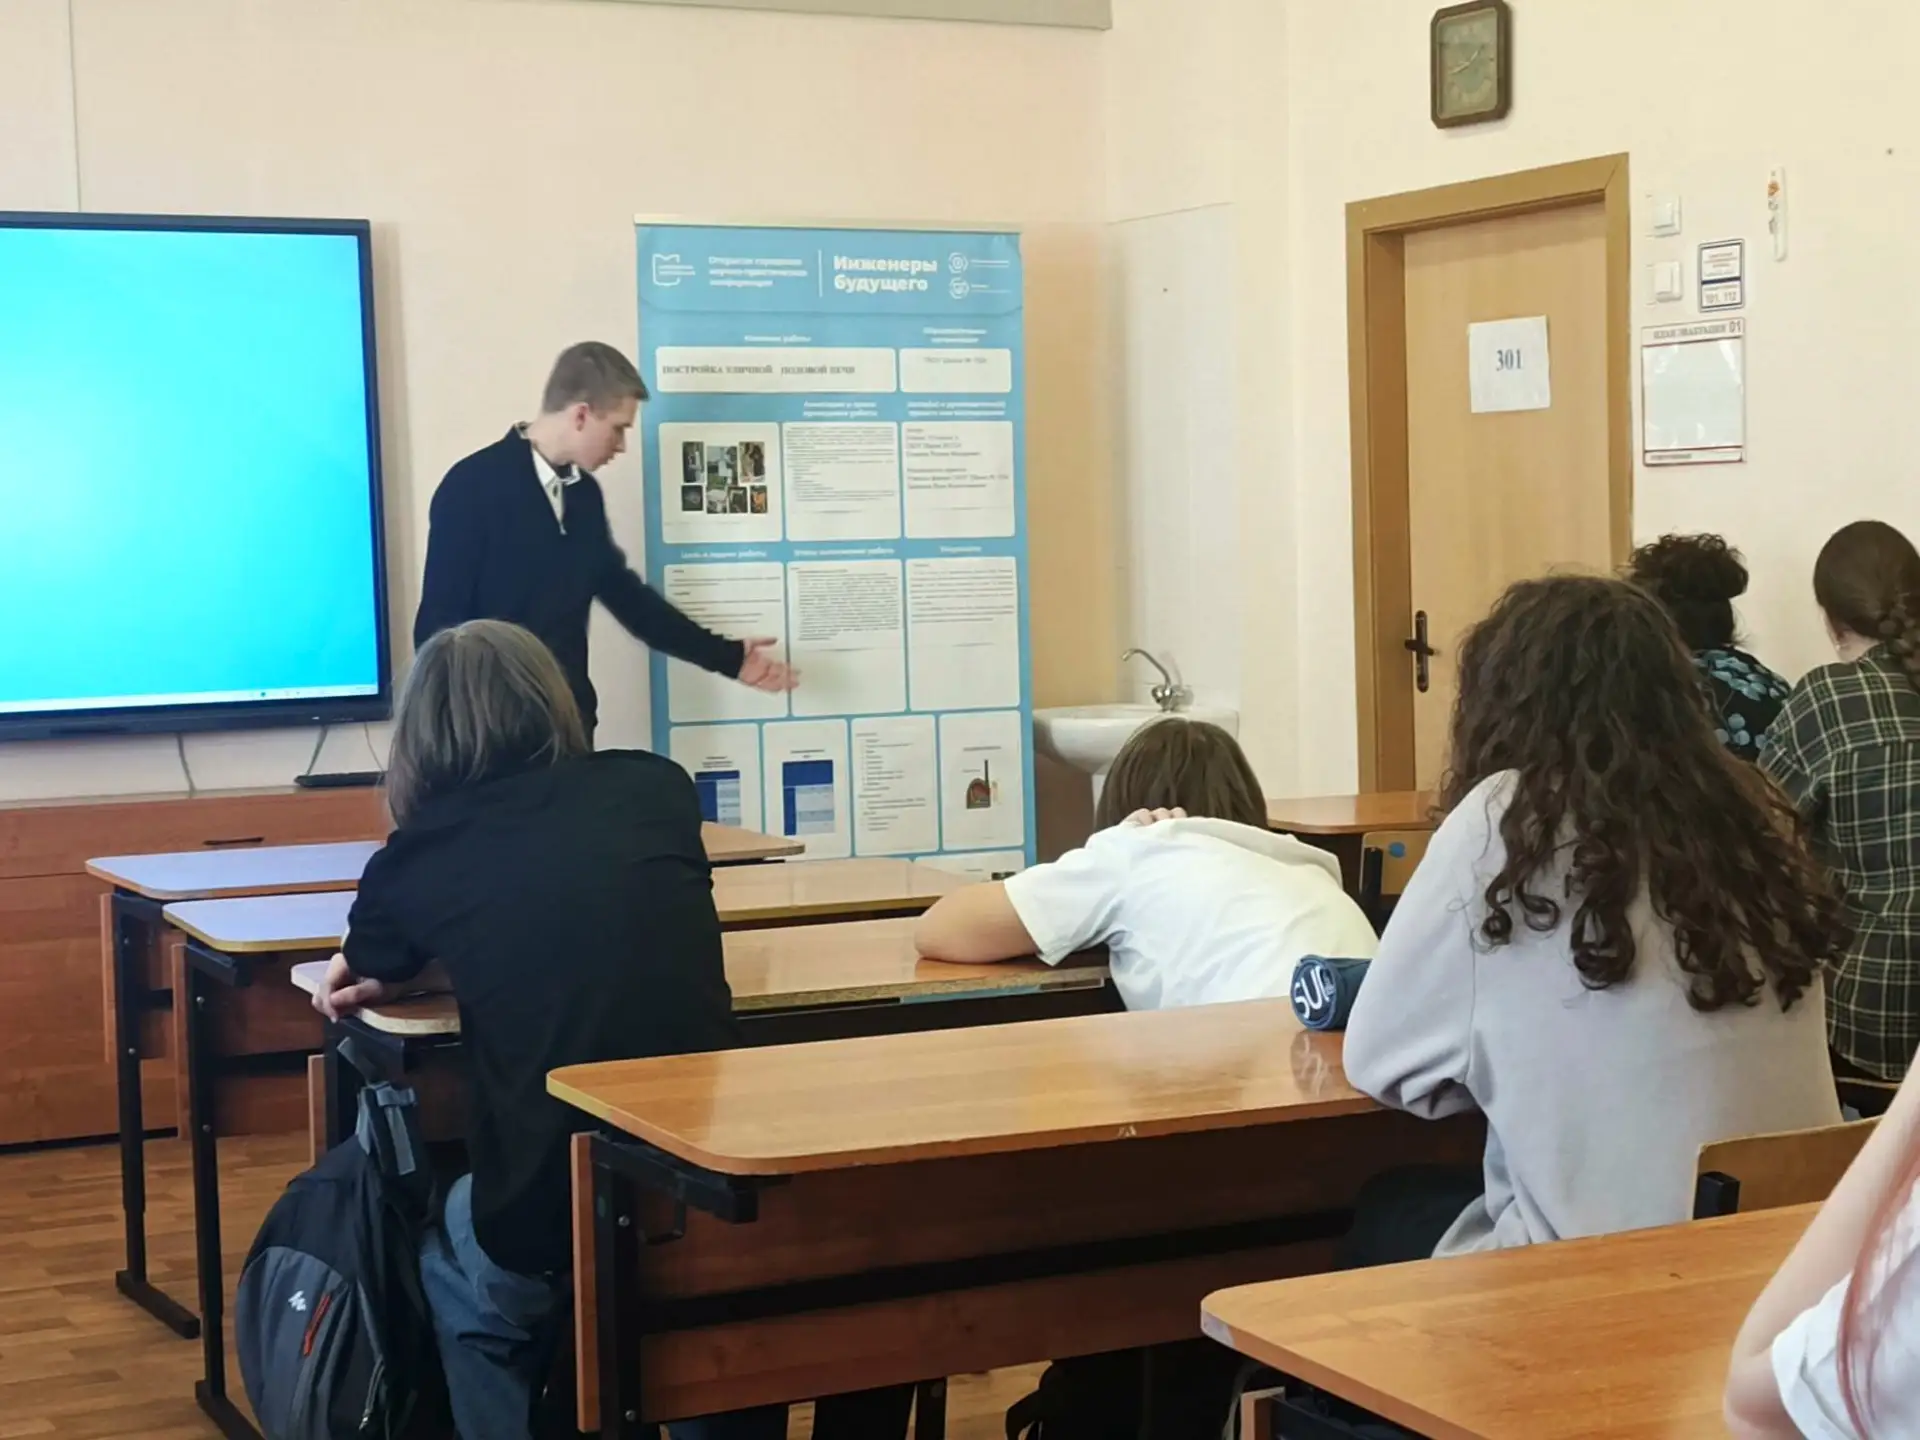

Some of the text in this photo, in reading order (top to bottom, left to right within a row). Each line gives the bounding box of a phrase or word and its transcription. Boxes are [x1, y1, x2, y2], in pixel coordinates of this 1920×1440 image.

[833, 255, 938, 275] Инженеры
[834, 274, 929, 294] будущего
[1728, 320, 1741, 333] 01
[662, 364, 723, 375] ПОСТРОЙКА
[1496, 348, 1521, 371] 301
